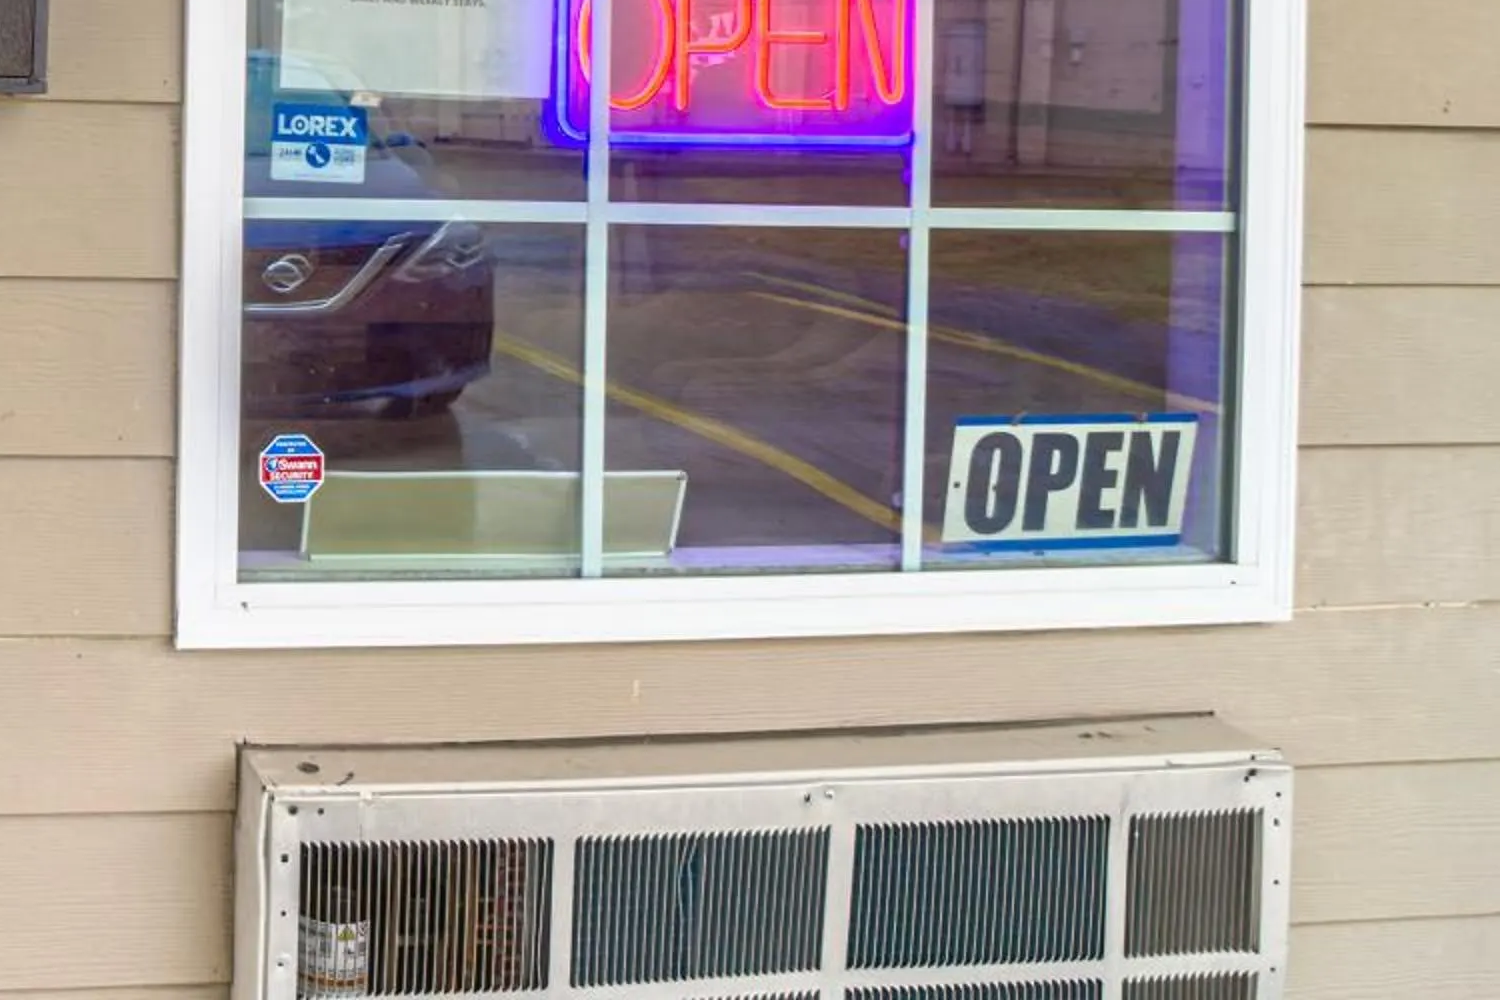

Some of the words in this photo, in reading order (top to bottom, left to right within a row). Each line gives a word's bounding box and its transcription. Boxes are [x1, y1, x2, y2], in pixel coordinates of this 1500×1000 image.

[278, 113, 357, 137] LOREX
[278, 458, 318, 471] Swann
[964, 430, 1181, 535] OPEN
